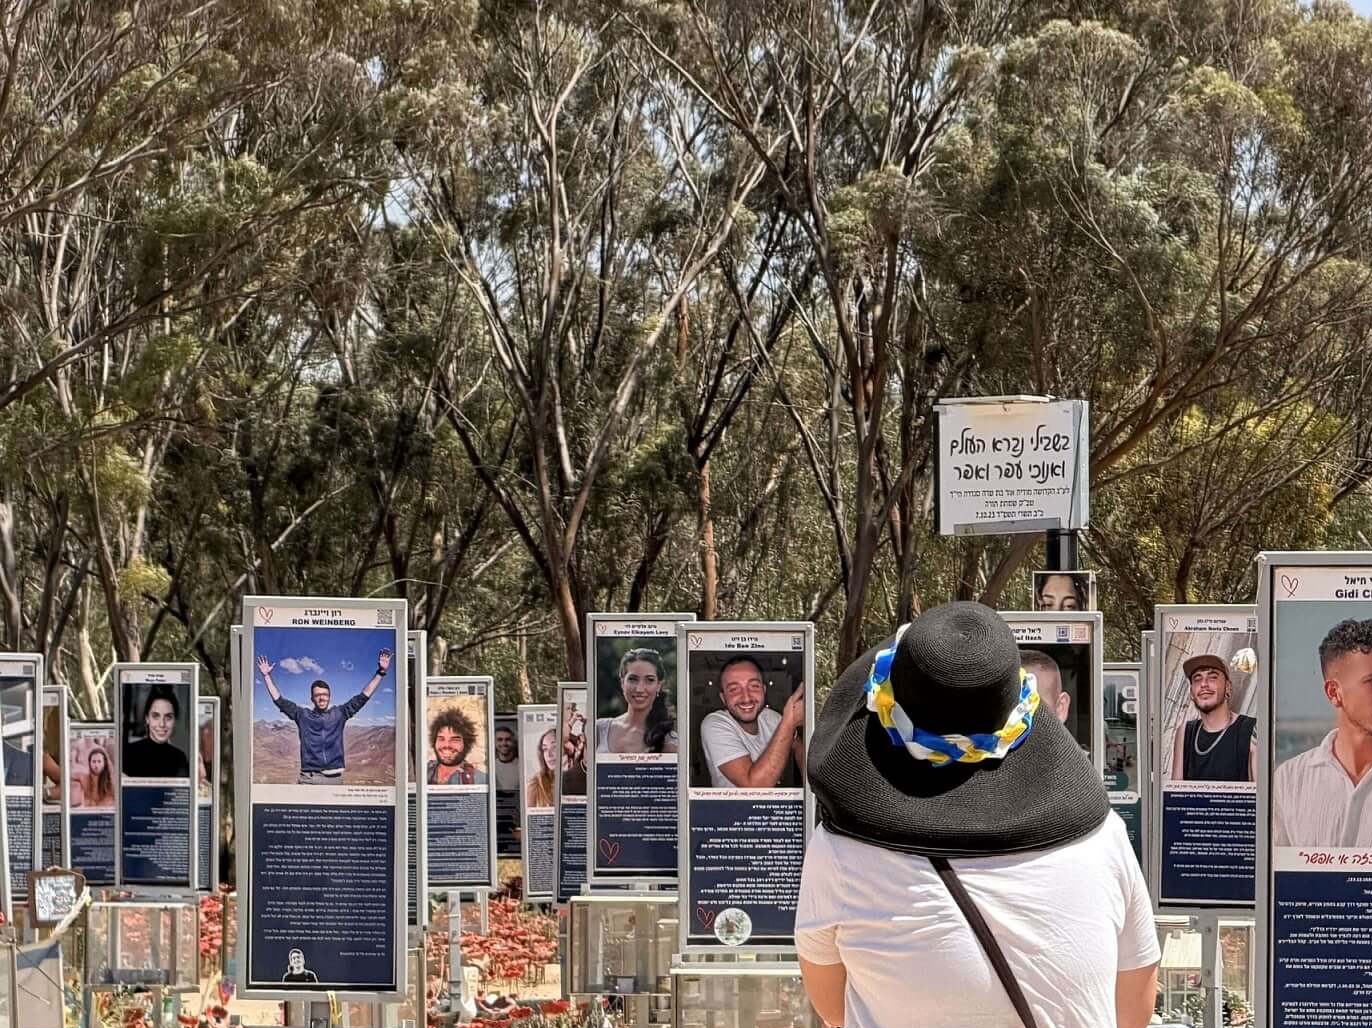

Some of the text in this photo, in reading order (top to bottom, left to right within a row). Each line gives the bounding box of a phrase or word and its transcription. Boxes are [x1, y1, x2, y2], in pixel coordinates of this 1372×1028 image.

[950, 425, 1070, 457] בשבילי נברא העולם
[953, 460, 1065, 484] ואנוכי עפר ואפר
[1345, 576, 1366, 585] חיאל
[1335, 589, 1359, 598] Gidi
[1338, 854, 1349, 865] אי
